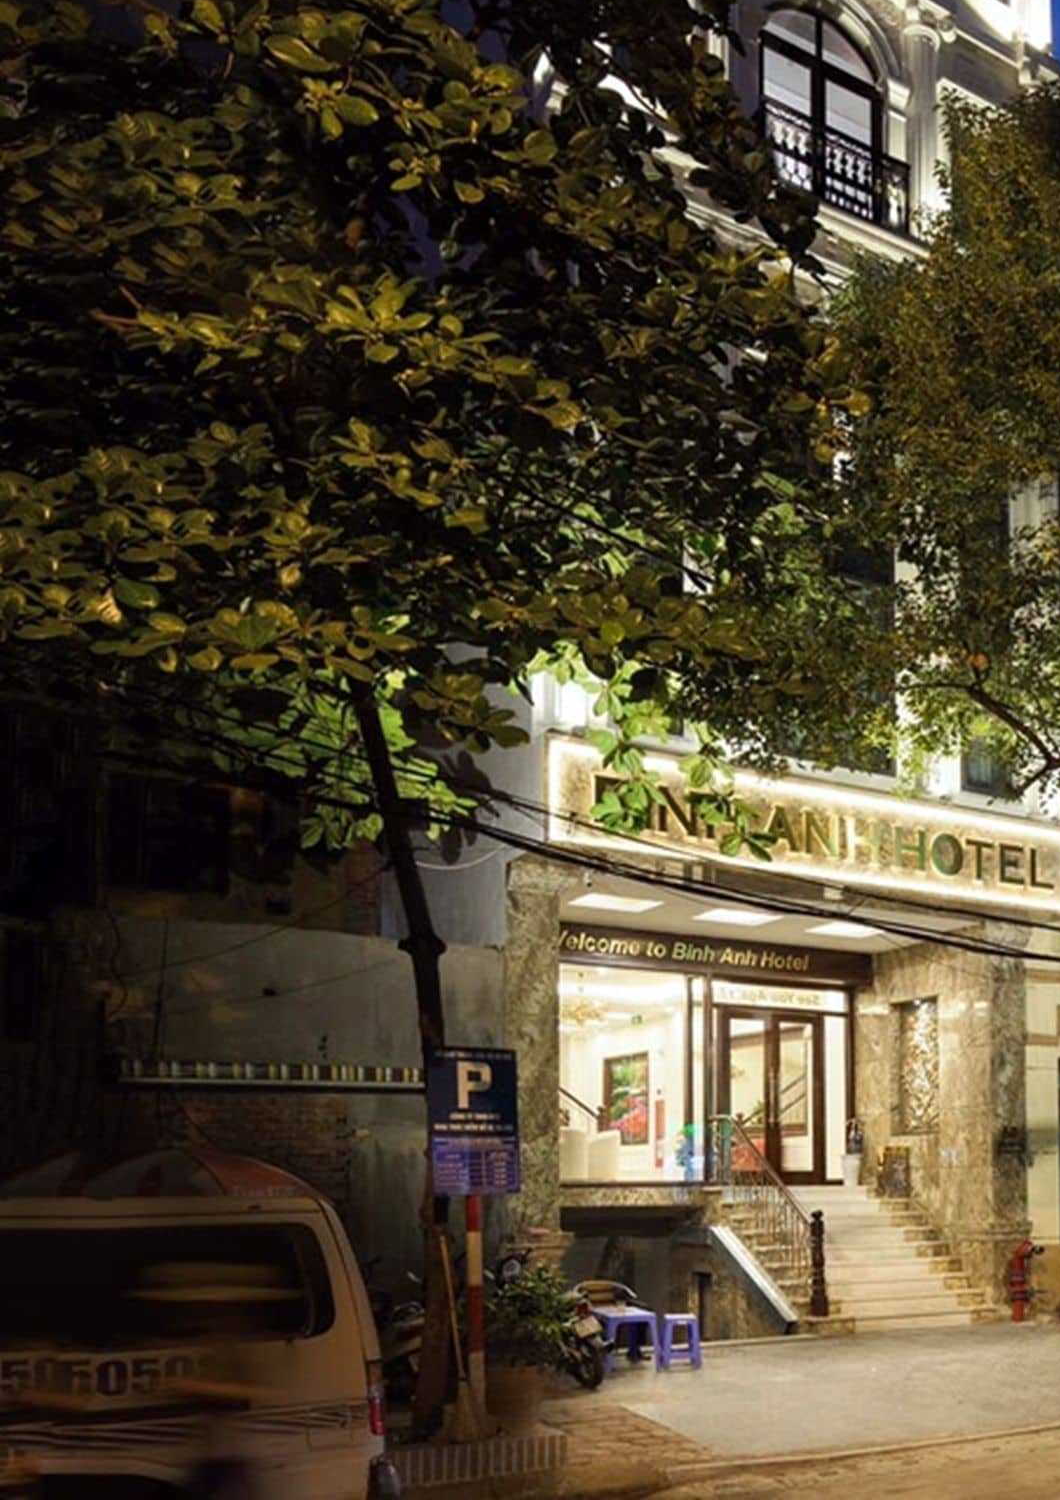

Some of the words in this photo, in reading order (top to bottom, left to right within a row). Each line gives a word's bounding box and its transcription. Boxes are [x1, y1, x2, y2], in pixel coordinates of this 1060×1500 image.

[764, 800, 882, 869] ANH
[892, 823, 1056, 890] HOTEL
[646, 940, 667, 958] to
[671, 943, 716, 964] Binh
[719, 947, 758, 967] Anh
[759, 951, 810, 972] Hotel
[455, 1060, 494, 1109] P
